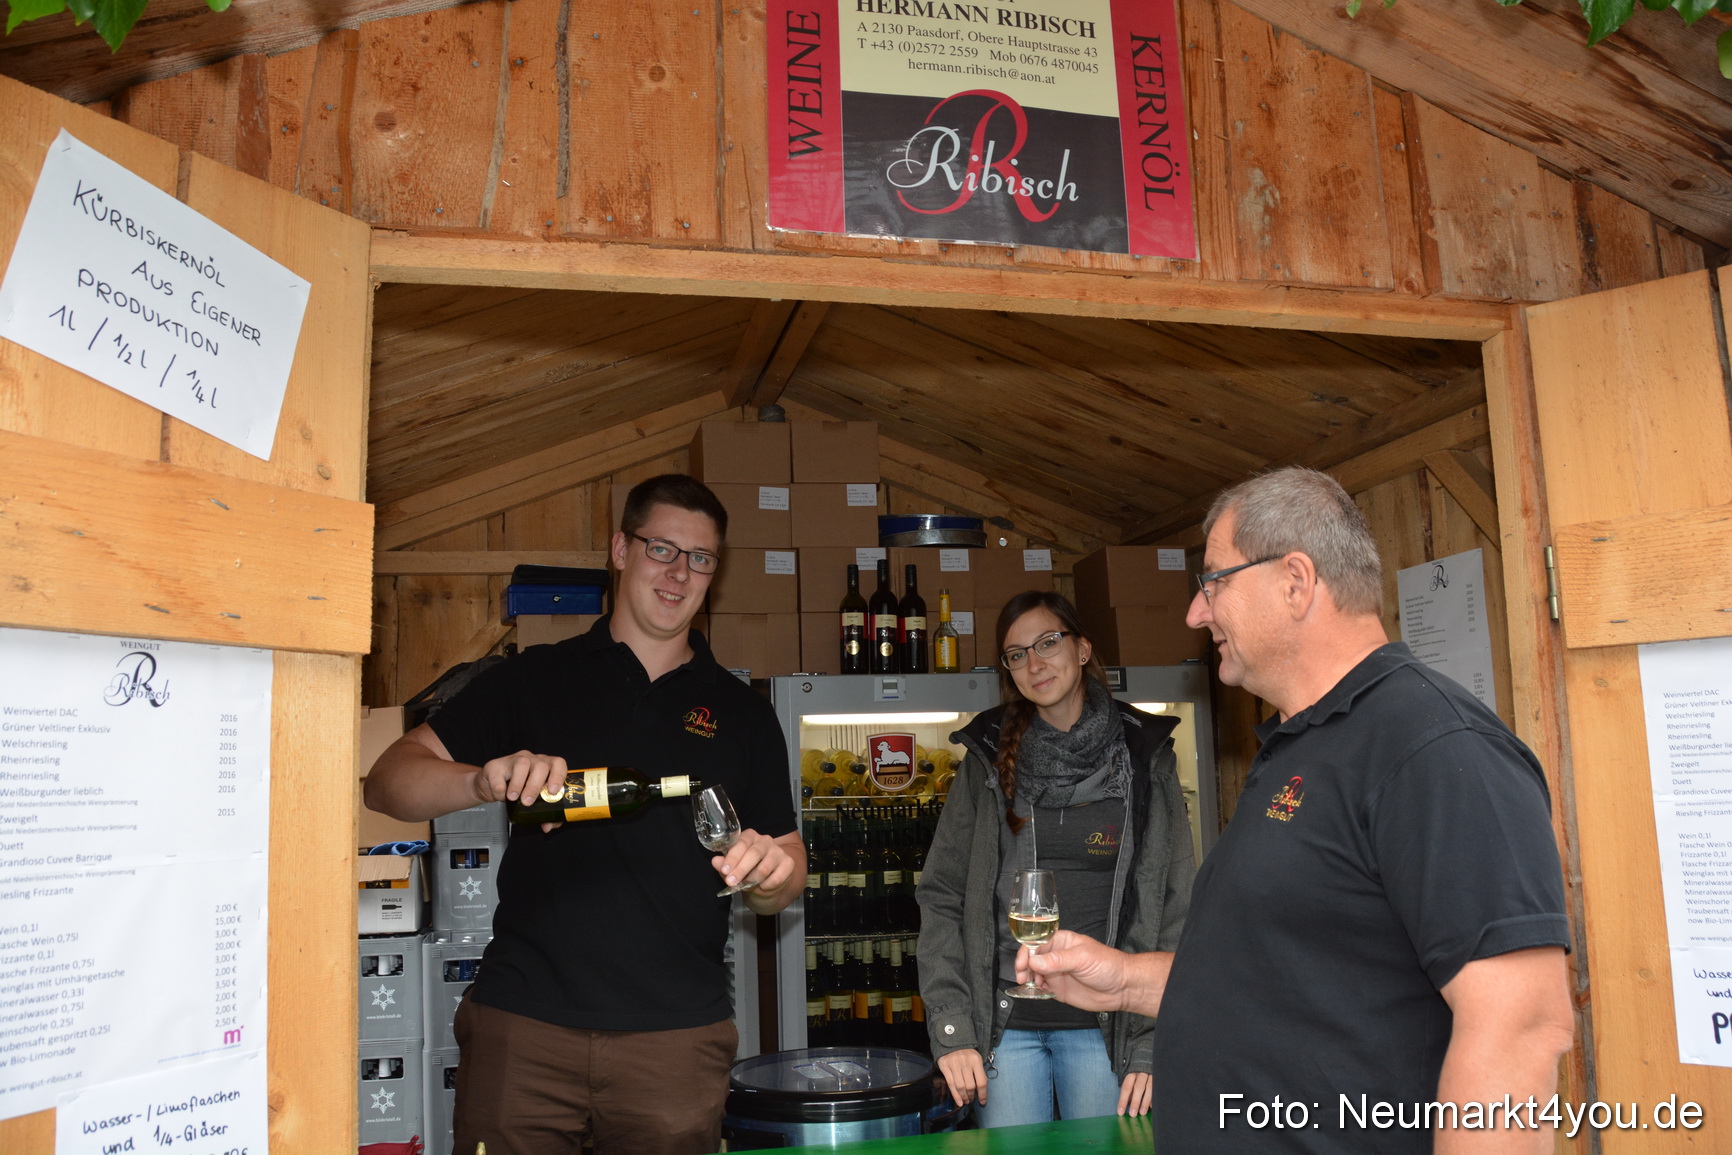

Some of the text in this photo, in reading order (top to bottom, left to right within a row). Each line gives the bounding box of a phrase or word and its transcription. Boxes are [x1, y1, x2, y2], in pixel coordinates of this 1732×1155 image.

[856, 0, 1097, 39] HERMANN RIBISCH
[857, 21, 1098, 58] A 2130 Paasdorf, Obere Hauptstrasse 43
[858, 38, 1099, 74] T +43 (0)2572 2559 Mob 0676 4870045
[908, 59, 1056, 85] hermann.ribisch@aon.at
[786, 10, 824, 161] WEINE
[1130, 31, 1180, 211] KERNÖL
[886, 125, 1079, 201] Ribisch
[73, 179, 226, 288] KÜRBISKERNÖL
[77, 268, 219, 356] PRODUKTION
[191, 290, 261, 347] EIGENER
[120, 640, 161, 651] WEINGUT
[103, 672, 171, 701] Ribisch
[1663, 689, 1719, 699] Weinviertel DAC
[1690, 700, 1719, 708] Veltliner
[3, 706, 78, 717] Weinviertel DAC
[1665, 711, 1715, 720] Welschriesling
[220, 714, 238, 723] 2016
[2, 722, 111, 734] Grüner Veltliner Exklusiv
[1666, 722, 1711, 730] Rheinriesling
[219, 728, 238, 737] 2016
[685, 726, 715, 739] WEINGUT
[1668, 732, 1712, 741] Rheinriesling
[1, 738, 68, 750] Welschriesling
[219, 742, 237, 751] 2016
[1669, 742, 1723, 751] Weißburgunder
[0, 755, 61, 766] Rheinriesling
[219, 757, 237, 765] 2015
[1670, 761, 1700, 769] Zweigelt
[0, 771, 60, 782] Rheinriesling
[218, 771, 236, 780] 2016
[883, 776, 904, 785] 1628
[0, 787, 104, 798] Weißburgunder lieblich
[218, 785, 236, 794] 2016
[1673, 788, 1709, 796] Grandioso
[17, 799, 87, 808] Niederösterreichische
[87, 798, 138, 807] Weinprämierung
[217, 808, 236, 817] 2015
[835, 799, 945, 822] Neumarkte
[1676, 809, 1703, 818] Riesling
[0, 813, 38, 825] Zweigelt
[15, 823, 138, 834] Niederösterreichische Weinprämierung
[46, 853, 113, 865] Cuvee Barrique
[13, 868, 136, 883] Niederösterreichische Weinprämierung
[1682, 870, 1715, 878] Weinglas
[0, 886, 74, 900] iesling Frizzante
[215, 904, 231, 913] 2,00
[215, 916, 236, 926] 15,00
[21, 923, 39, 935] 0,1l
[215, 929, 231, 938] 3,00
[0, 932, 79, 949] asche Wein 0,75l
[215, 941, 236, 951] 20,00
[1, 950, 55, 964] izzante 0,1l
[215, 954, 231, 964] 3,00
[0, 959, 95, 979] asche Frizzante 0,75l
[215, 966, 231, 976] 2,00
[1693, 968, 1732, 979] Wasse
[0, 968, 126, 994] einglas mit Umhängetasche
[215, 979, 231, 989] 3,50
[0, 988, 85, 1008] ineralwasser 0,33l
[215, 992, 231, 1002] 2,00
[1706, 988, 1732, 998] und
[0, 1002, 85, 1022] ineralwasser 0,75l
[215, 1004, 231, 1014] 2,00
[0, 1017, 74, 1038] einschorle 0,25l
[215, 1017, 231, 1027] 2,50
[48, 1025, 111, 1046] gespritzt 0,25l
[10, 1045, 76, 1067] Bio-Limonade
[0, 1070, 83, 1094] w.weingut-ribisch.at
[156, 1089, 241, 1115] Limoflaschen
[103, 1137, 135, 1155] und
